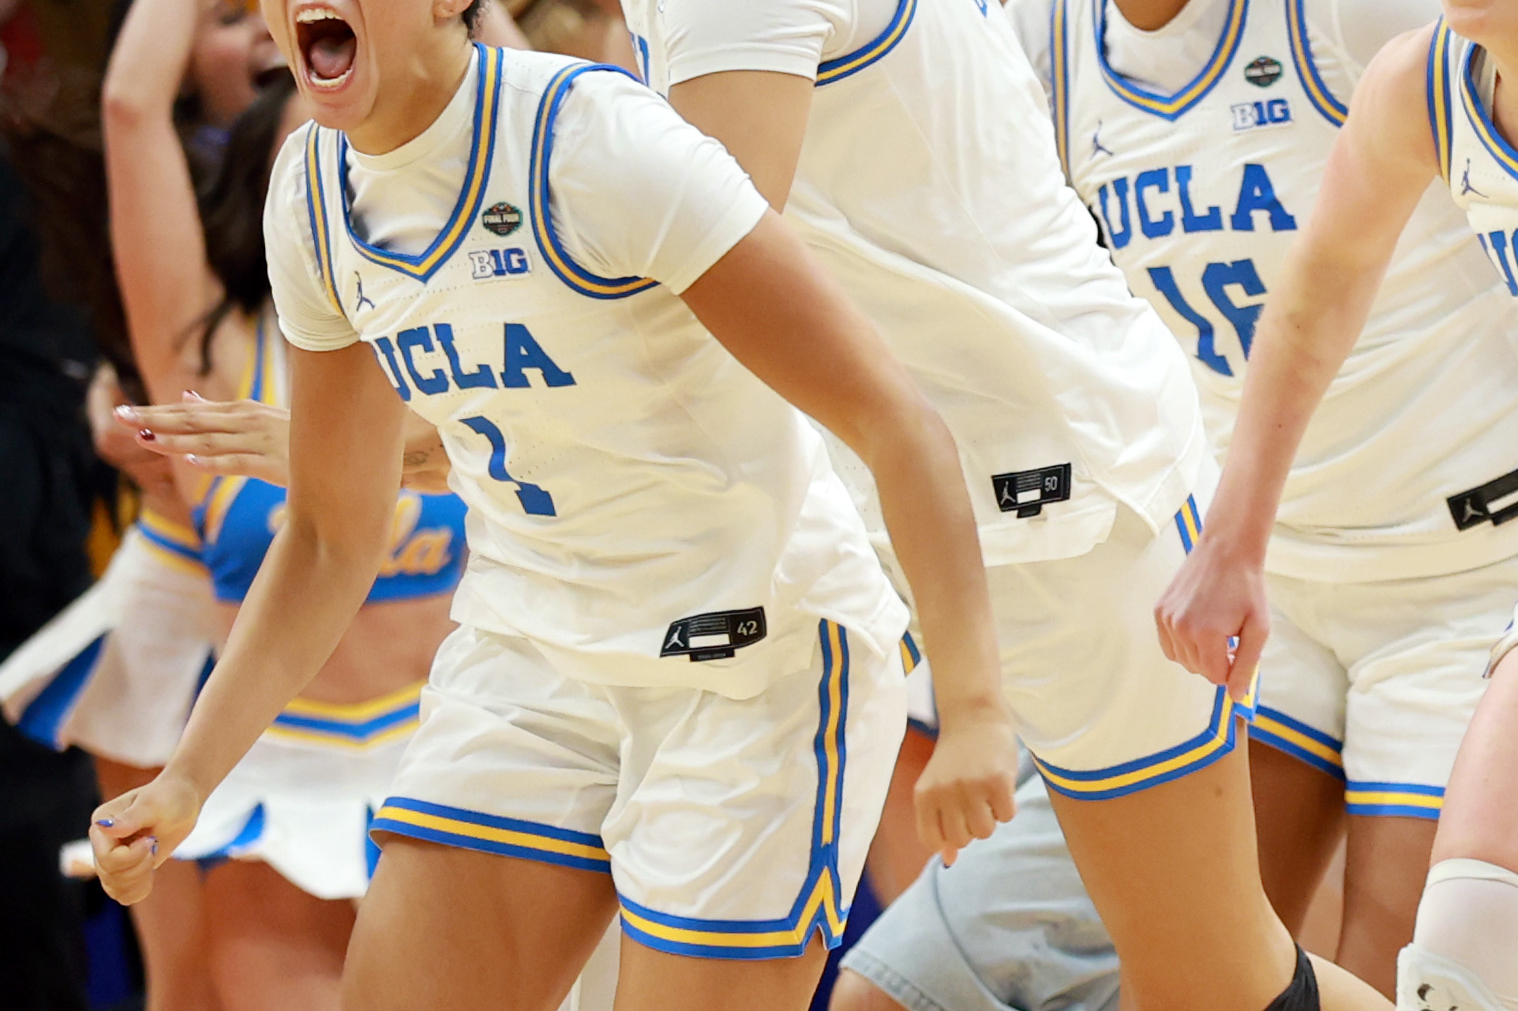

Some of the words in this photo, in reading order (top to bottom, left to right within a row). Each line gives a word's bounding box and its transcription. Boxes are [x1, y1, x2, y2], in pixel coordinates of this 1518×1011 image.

[1098, 163, 1298, 250] UCLA
[458, 415, 557, 517] 1
[1044, 475, 1058, 492] 50
[737, 620, 758, 636] 42
